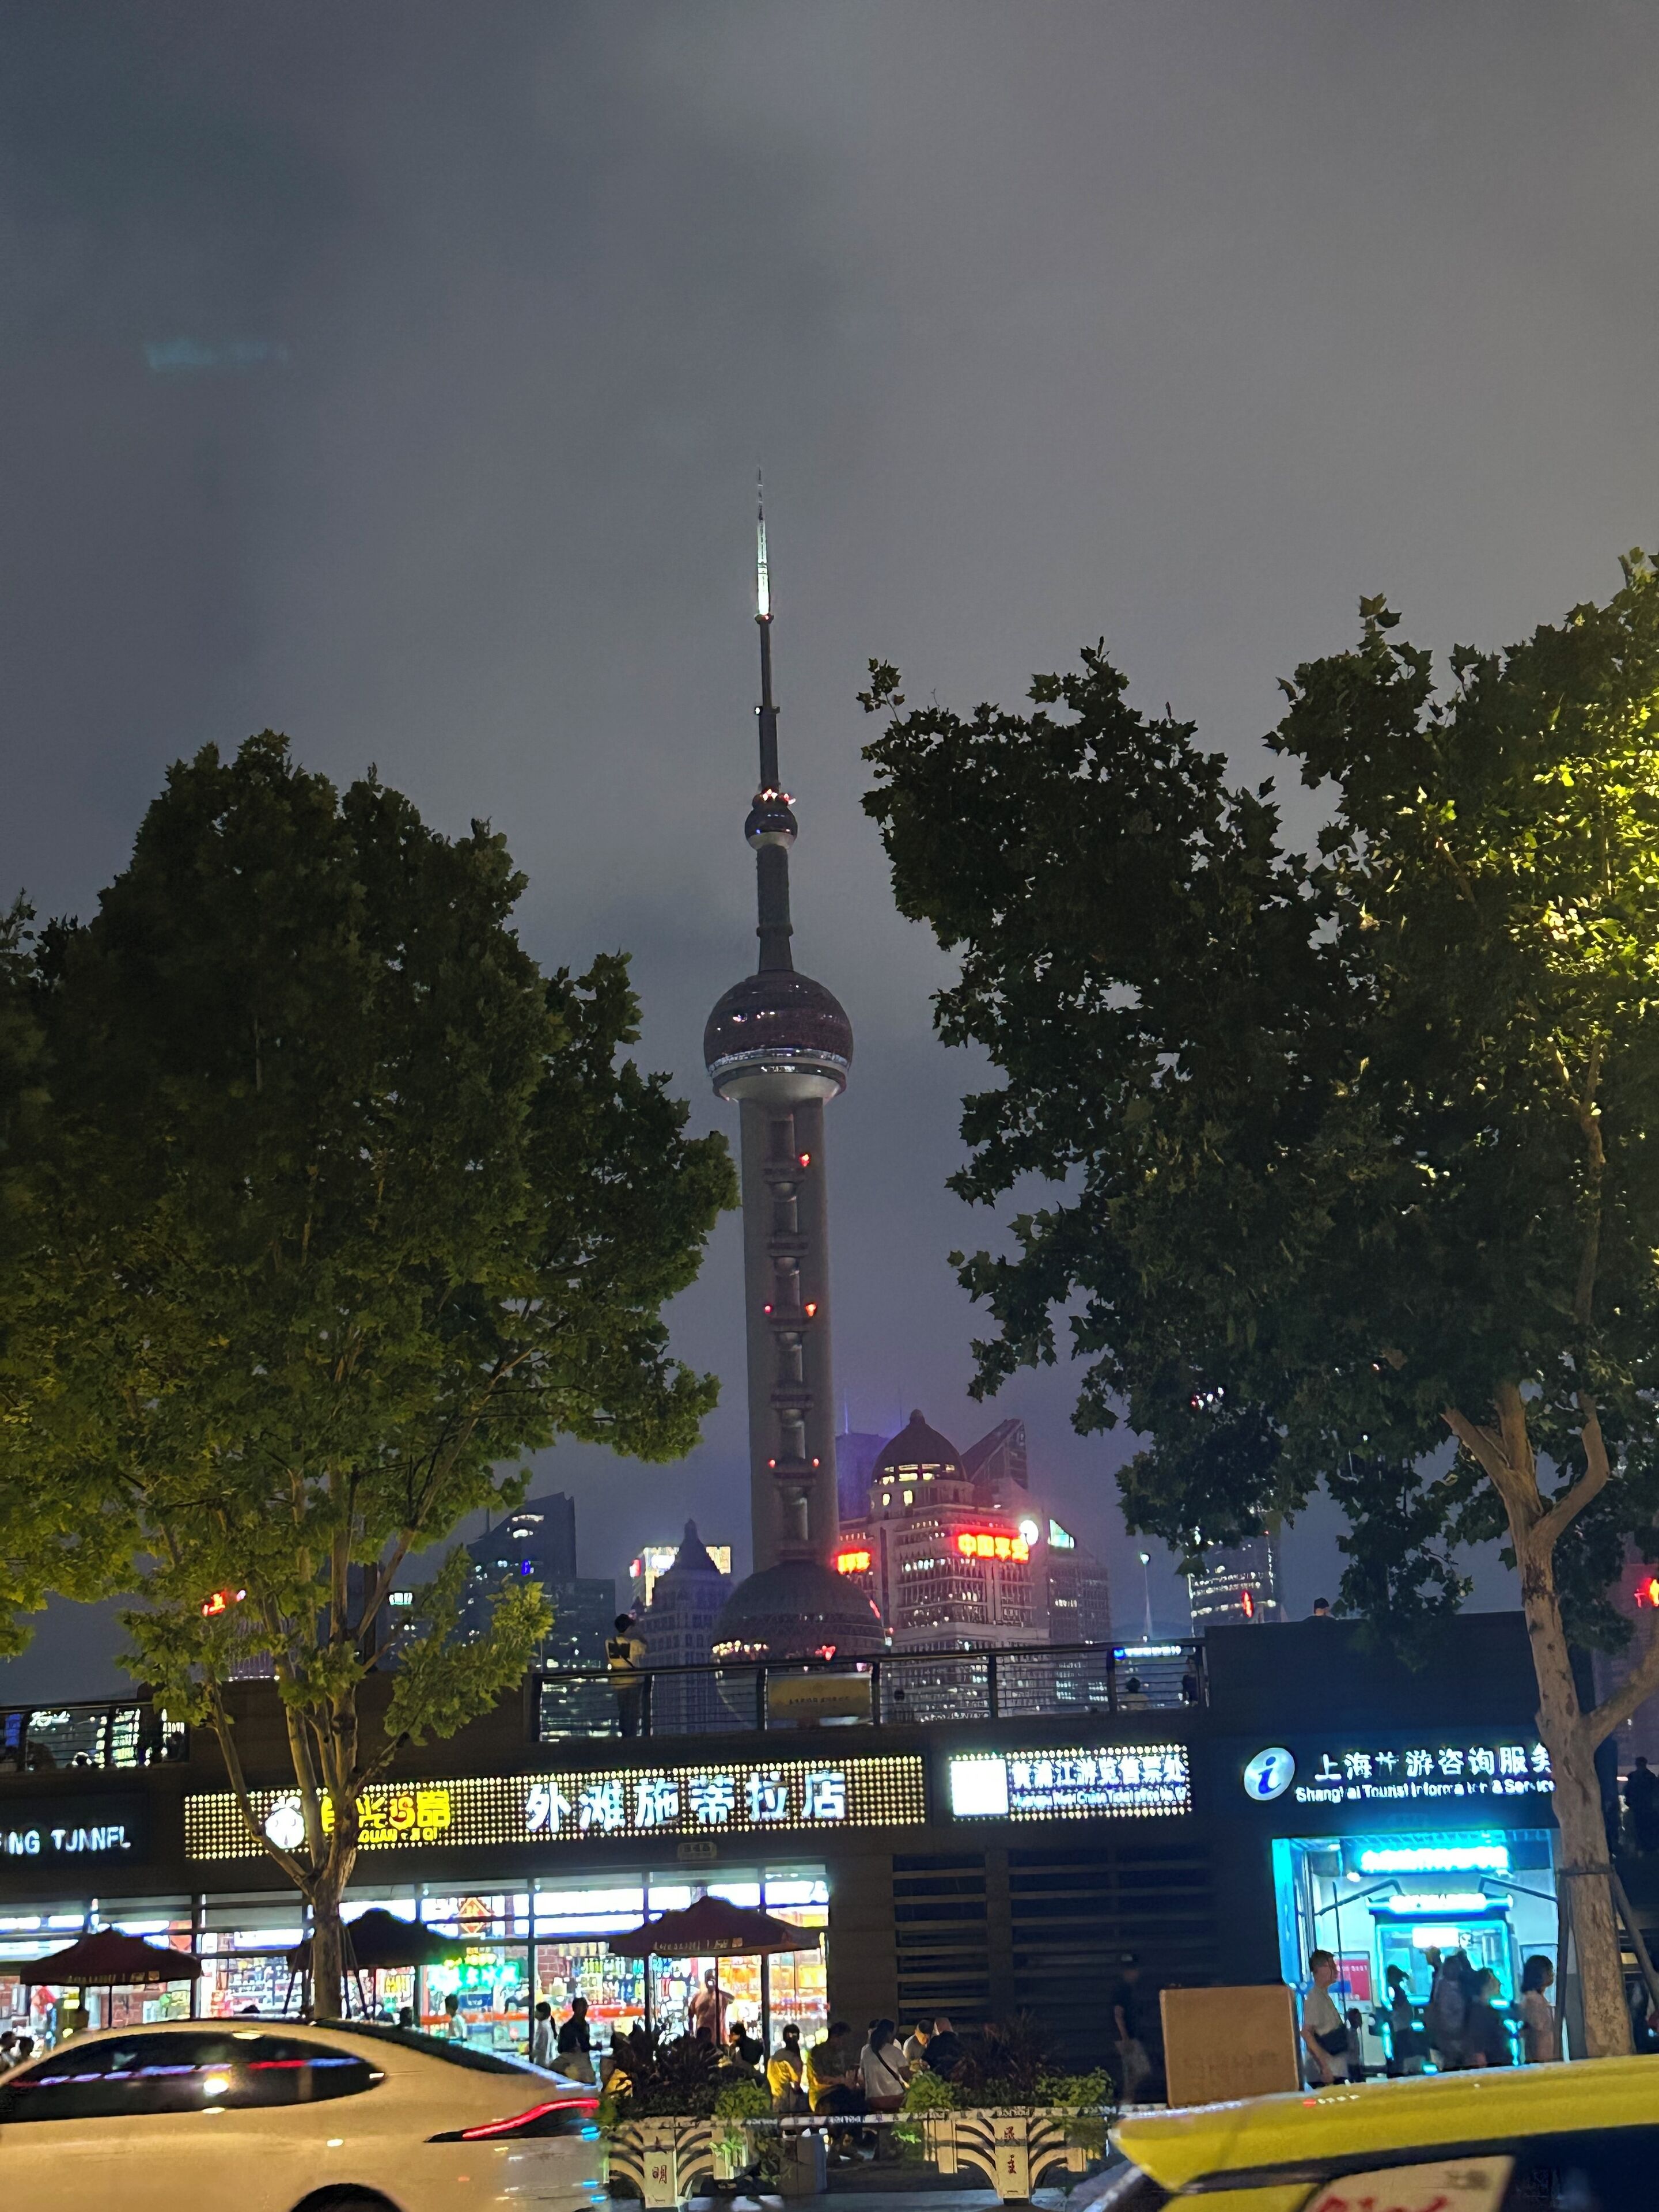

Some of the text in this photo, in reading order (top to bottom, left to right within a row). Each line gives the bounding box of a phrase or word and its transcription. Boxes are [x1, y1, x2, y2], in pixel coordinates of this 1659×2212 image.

[525, 1770, 846, 1833] 外滩施蒂拉店
